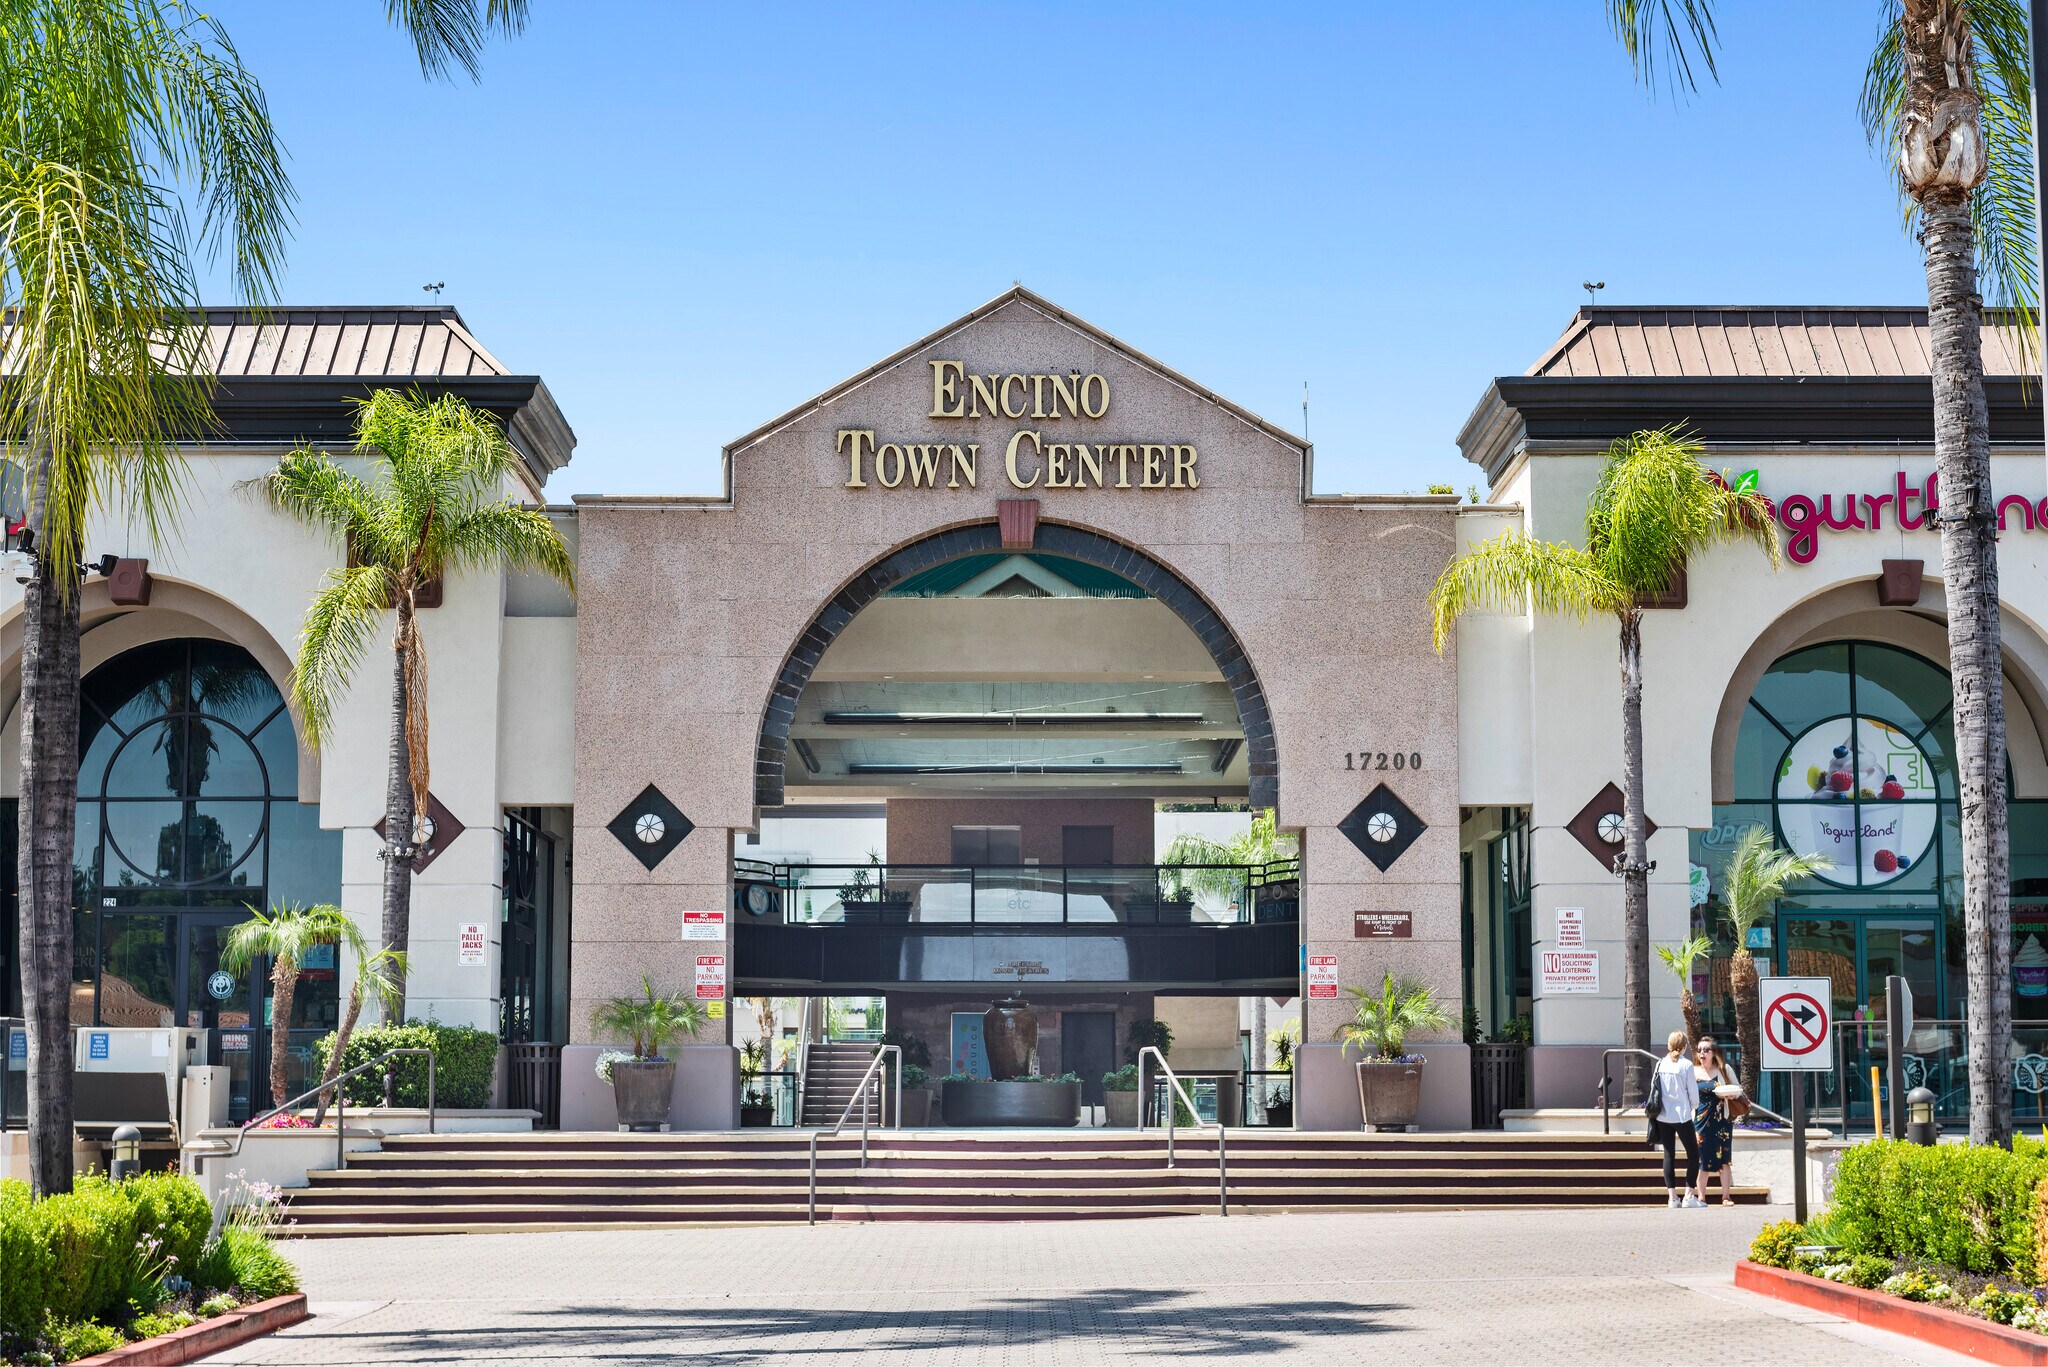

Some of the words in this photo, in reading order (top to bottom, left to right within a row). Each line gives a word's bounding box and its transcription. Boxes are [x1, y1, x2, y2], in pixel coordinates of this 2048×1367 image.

[928, 359, 1111, 419] ENCINO
[837, 429, 980, 488] TOWN
[1003, 429, 1201, 490] CENTER
[1344, 752, 1422, 770] 17200
[103, 898, 116, 906] 224
[1749, 932, 1760, 944] A
[1544, 954, 1560, 972] NO
